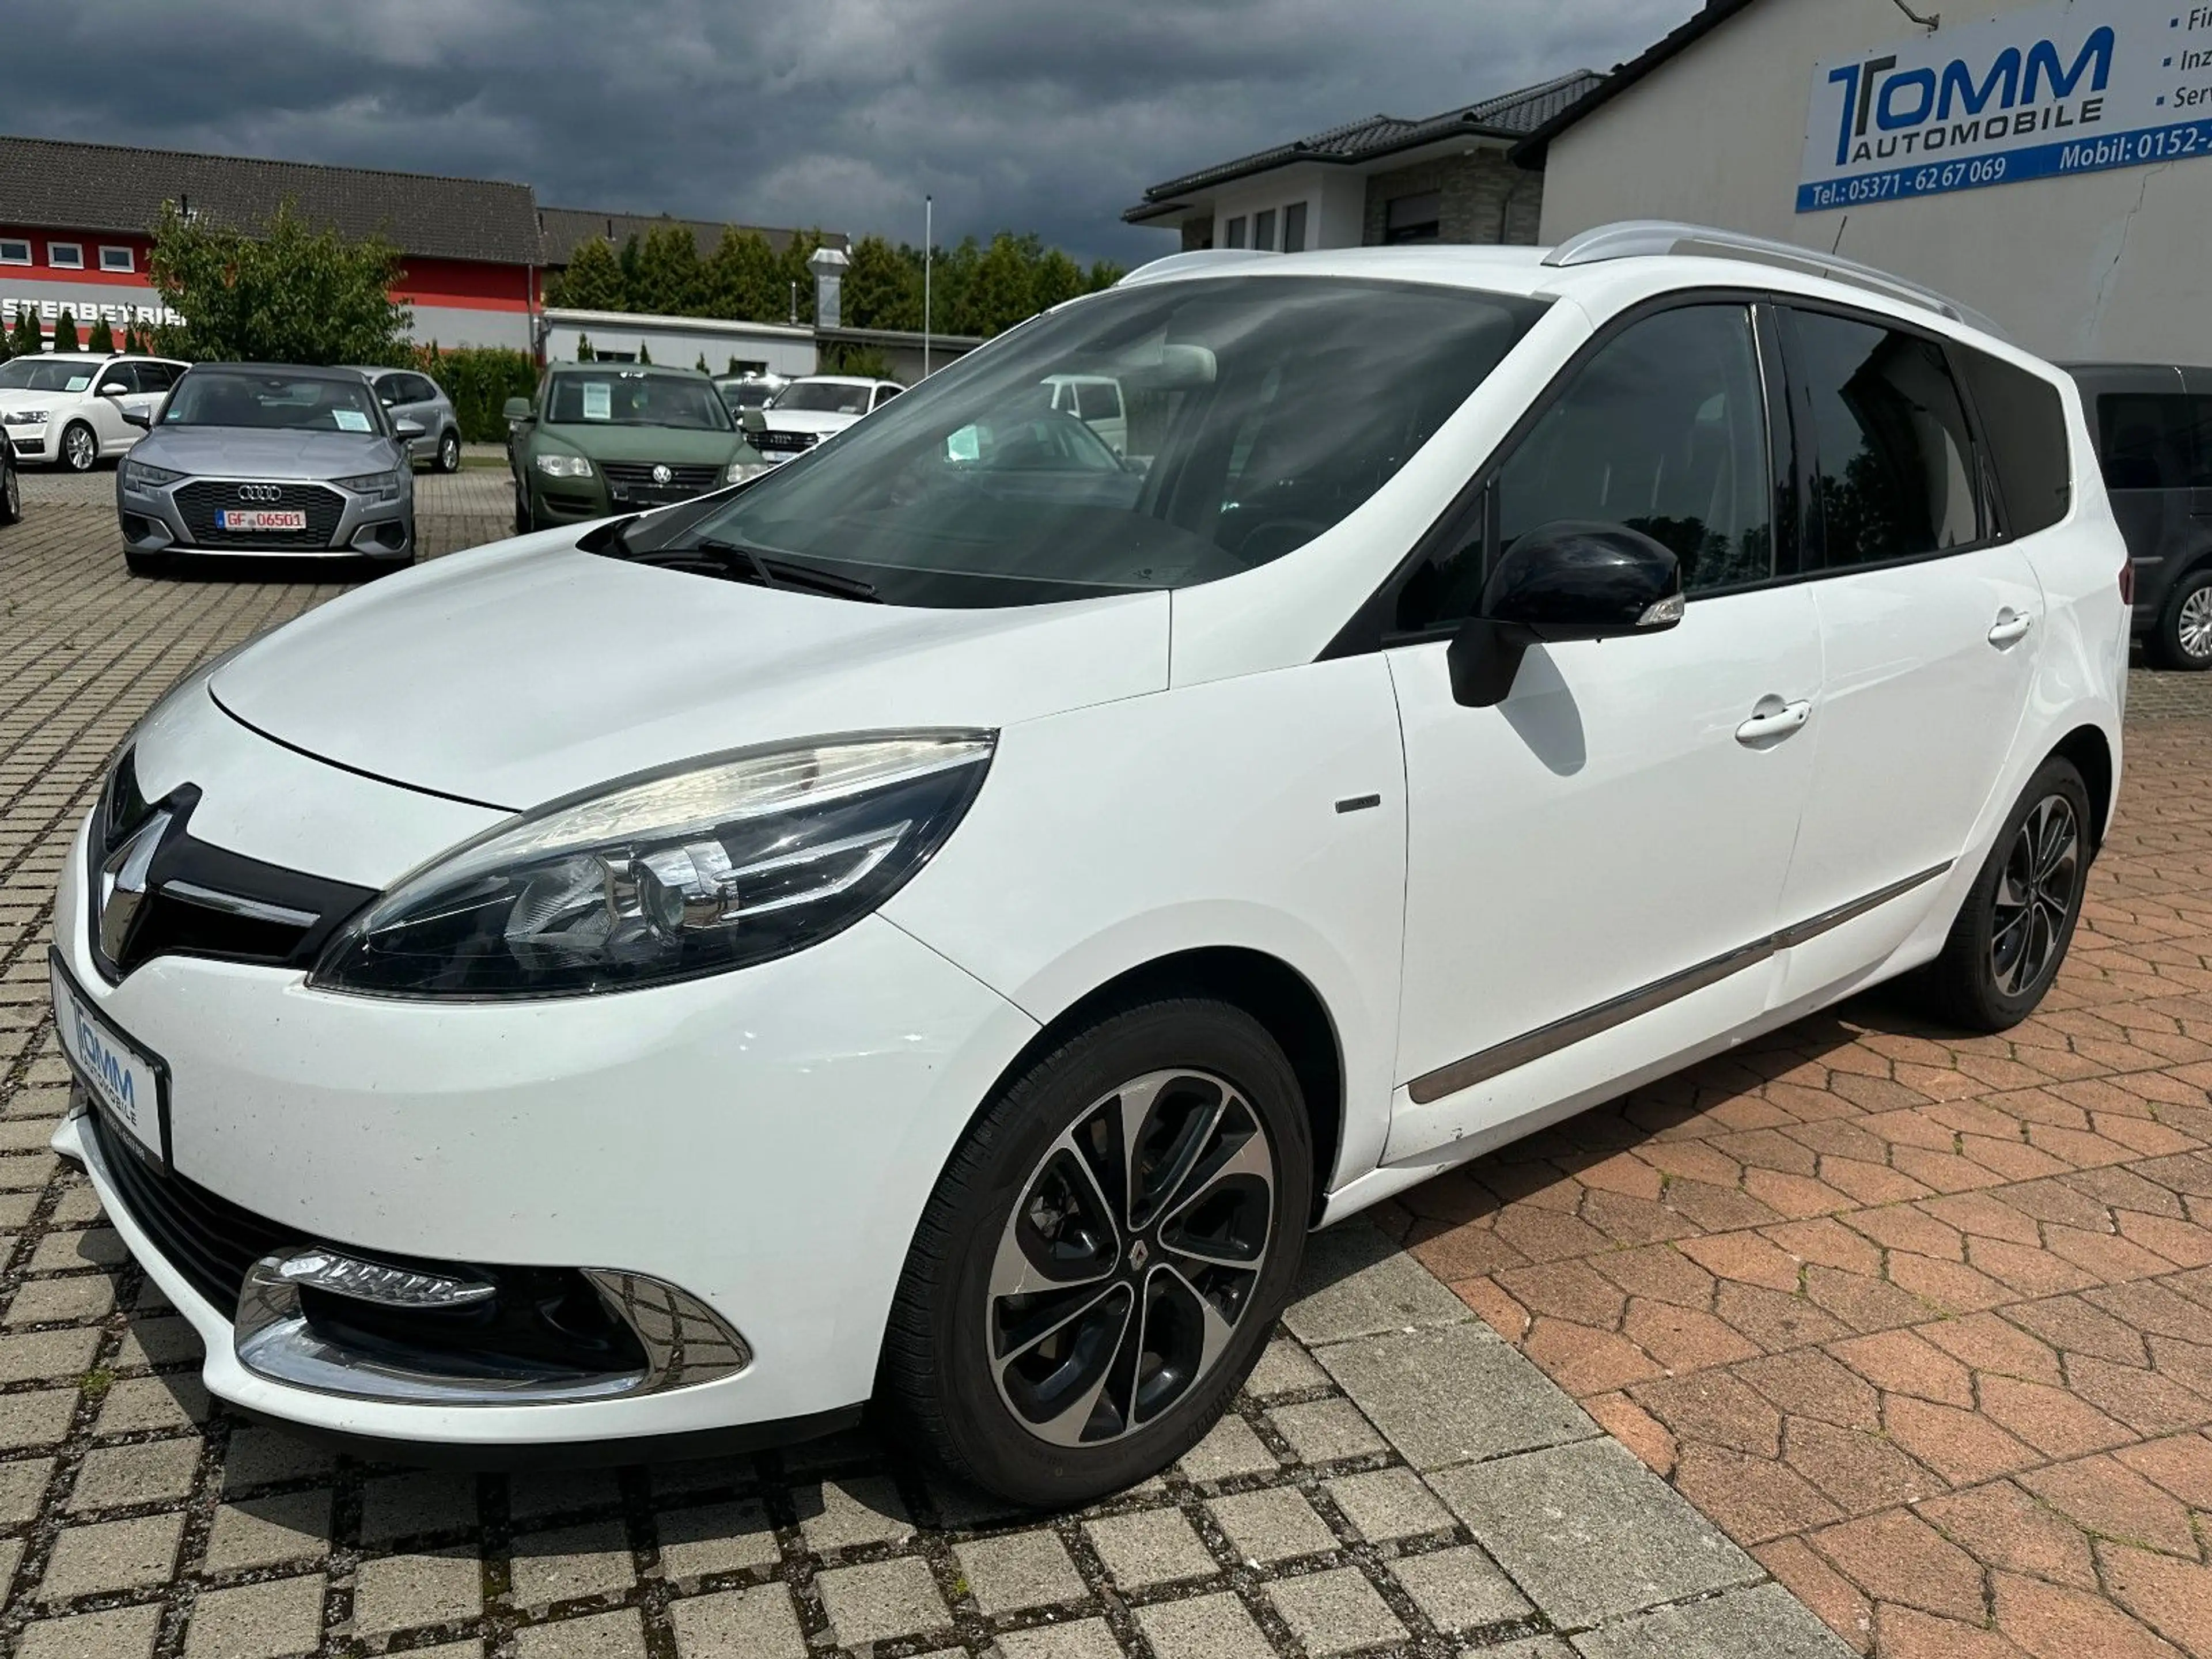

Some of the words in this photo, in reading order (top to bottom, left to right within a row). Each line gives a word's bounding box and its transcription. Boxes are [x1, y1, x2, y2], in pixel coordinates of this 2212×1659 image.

[1828, 26, 2115, 166] TOMM
[2174, 86, 2212, 108] Ser
[1852, 97, 2104, 163] AUTOMOBILE
[2059, 136, 2132, 169] Mobil:
[1813, 184, 1846, 206] Tel.:
[1849, 174, 1900, 200] 05371
[2, 298, 187, 326] STERBETRIE
[228, 513, 246, 526] GF
[257, 514, 302, 527] 06501
